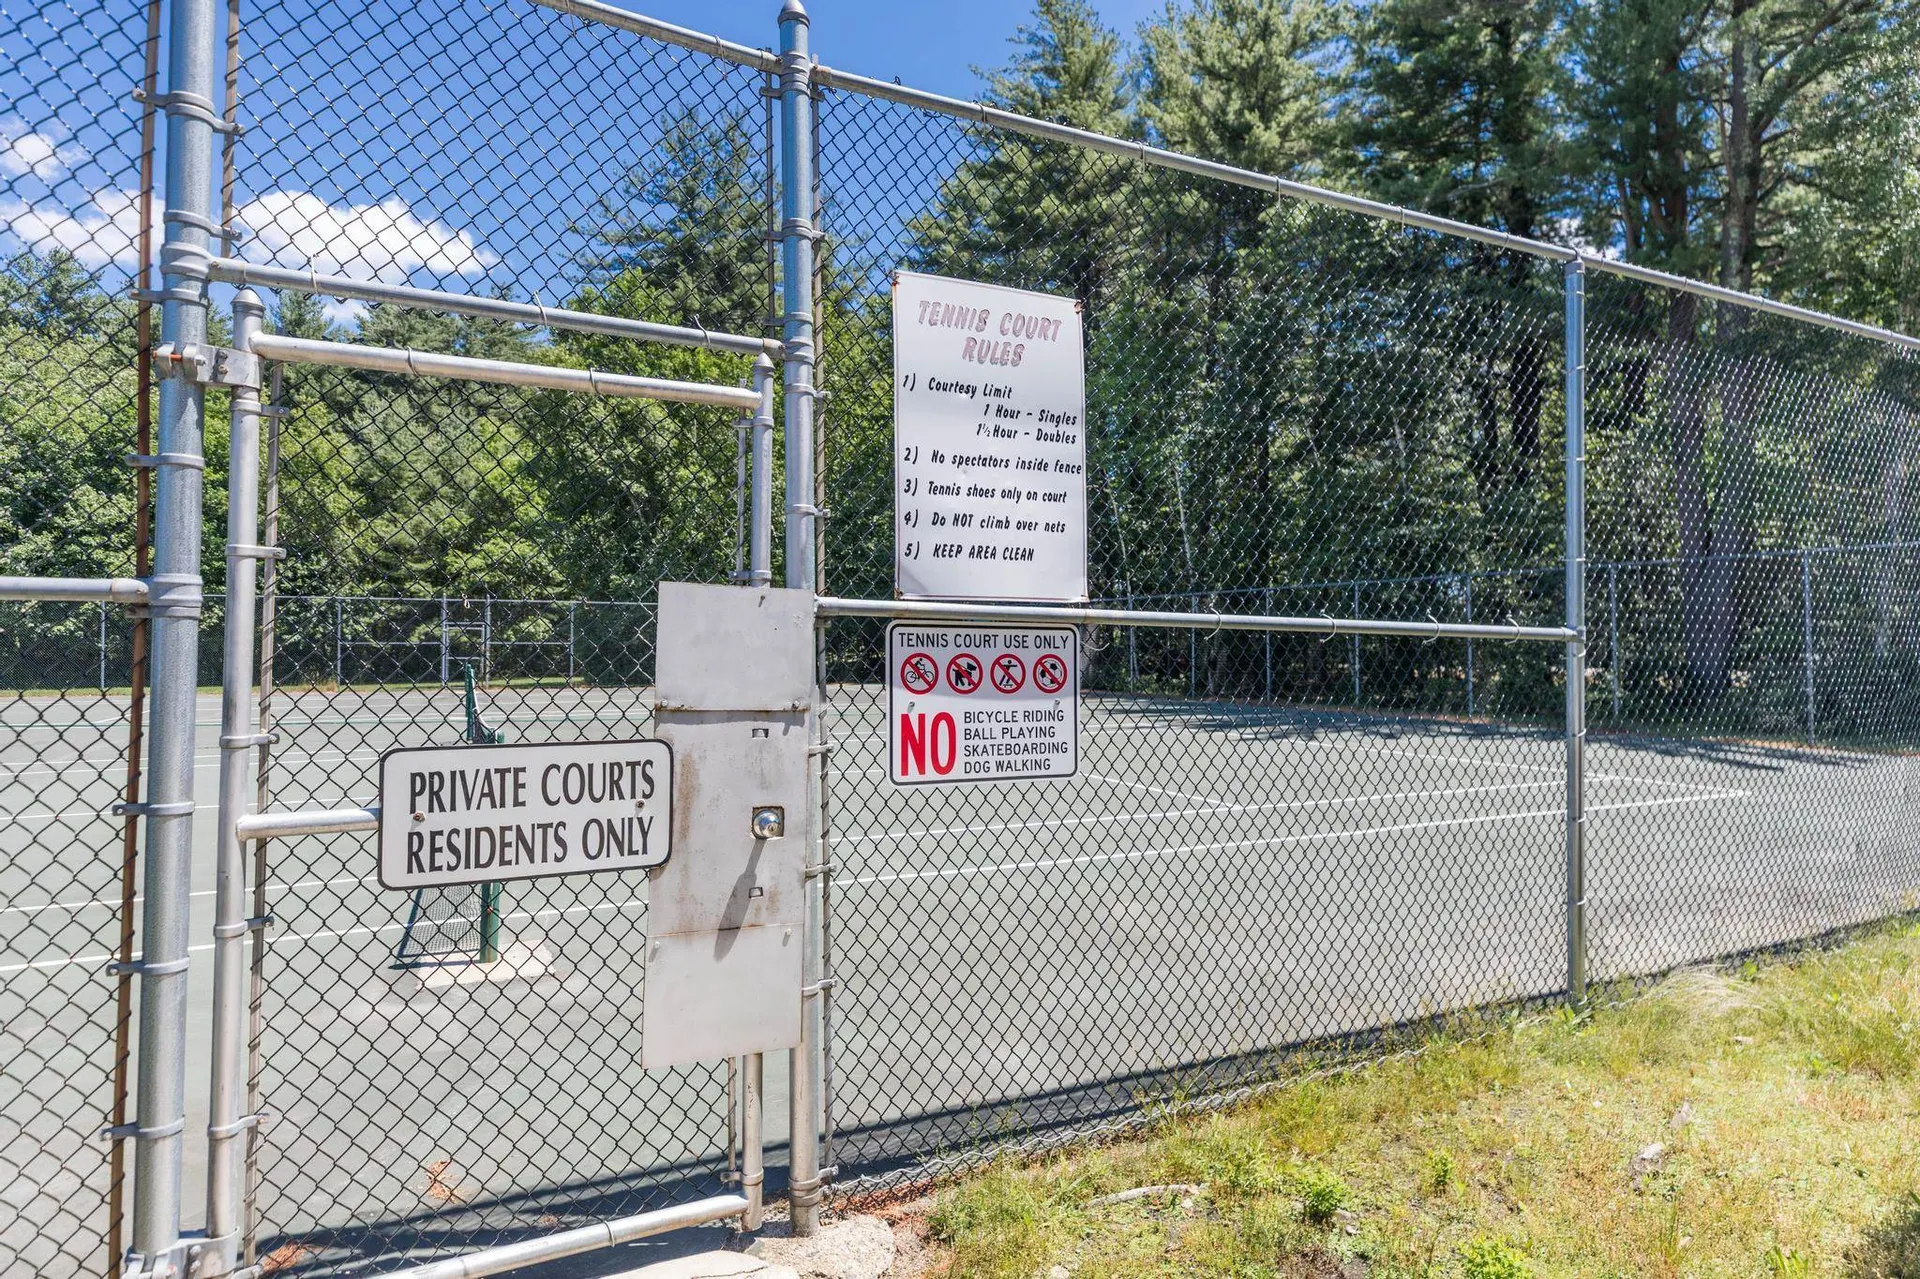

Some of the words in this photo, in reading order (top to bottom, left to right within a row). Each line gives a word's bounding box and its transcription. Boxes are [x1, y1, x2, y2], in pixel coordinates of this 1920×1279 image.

[918, 301, 990, 332] TENNIS
[1000, 313, 1062, 342] COURT
[962, 337, 1025, 367] RULES
[903, 373, 916, 391] 1)
[929, 377, 977, 399] Courtesy
[983, 383, 1013, 399] Limit
[984, 404, 990, 416] 1
[996, 405, 1021, 419] Hour
[1038, 409, 1077, 428] Singles
[993, 425, 1017, 439] Hour
[1036, 428, 1077, 445] Doubles
[904, 446, 918, 465] 2)
[932, 450, 945, 464] No
[951, 454, 1010, 469] spectators
[1016, 457, 1049, 472] inside
[1054, 460, 1082, 475] fence
[904, 478, 918, 496] 3)
[928, 481, 961, 496] Tennis
[966, 484, 995, 498] shoes
[1001, 487, 1022, 504] only
[1026, 492, 1037, 501] on
[1042, 491, 1067, 503] court
[904, 509, 918, 528] 4)
[932, 512, 945, 526] Do
[953, 514, 974, 528] NOT
[980, 516, 1010, 529] climb
[1016, 520, 1038, 531] over
[1044, 520, 1065, 533] nets
[905, 541, 920, 560] 5)
[933, 544, 962, 558] KEEP
[969, 545, 996, 560] AREA
[1002, 547, 1034, 561] CLEAN
[899, 633, 948, 648] TENNIS
[954, 634, 999, 648] COURT
[1004, 635, 1029, 648] USE
[1034, 636, 1069, 649] ONLY
[964, 711, 1018, 724] BICYCLE
[1023, 710, 1064, 723] RIDING
[901, 712, 956, 776] NO
[964, 728, 996, 740] BALL
[1001, 726, 1055, 739] PLAYING
[964, 742, 1068, 757] SKATEBOARDING
[964, 761, 990, 774] DOG
[995, 759, 1050, 773] WALKING
[410, 766, 526, 814] PRIVATE
[542, 759, 654, 806] COURTS
[406, 820, 568, 874] RESIDENTS
[582, 816, 654, 860] ONLY
